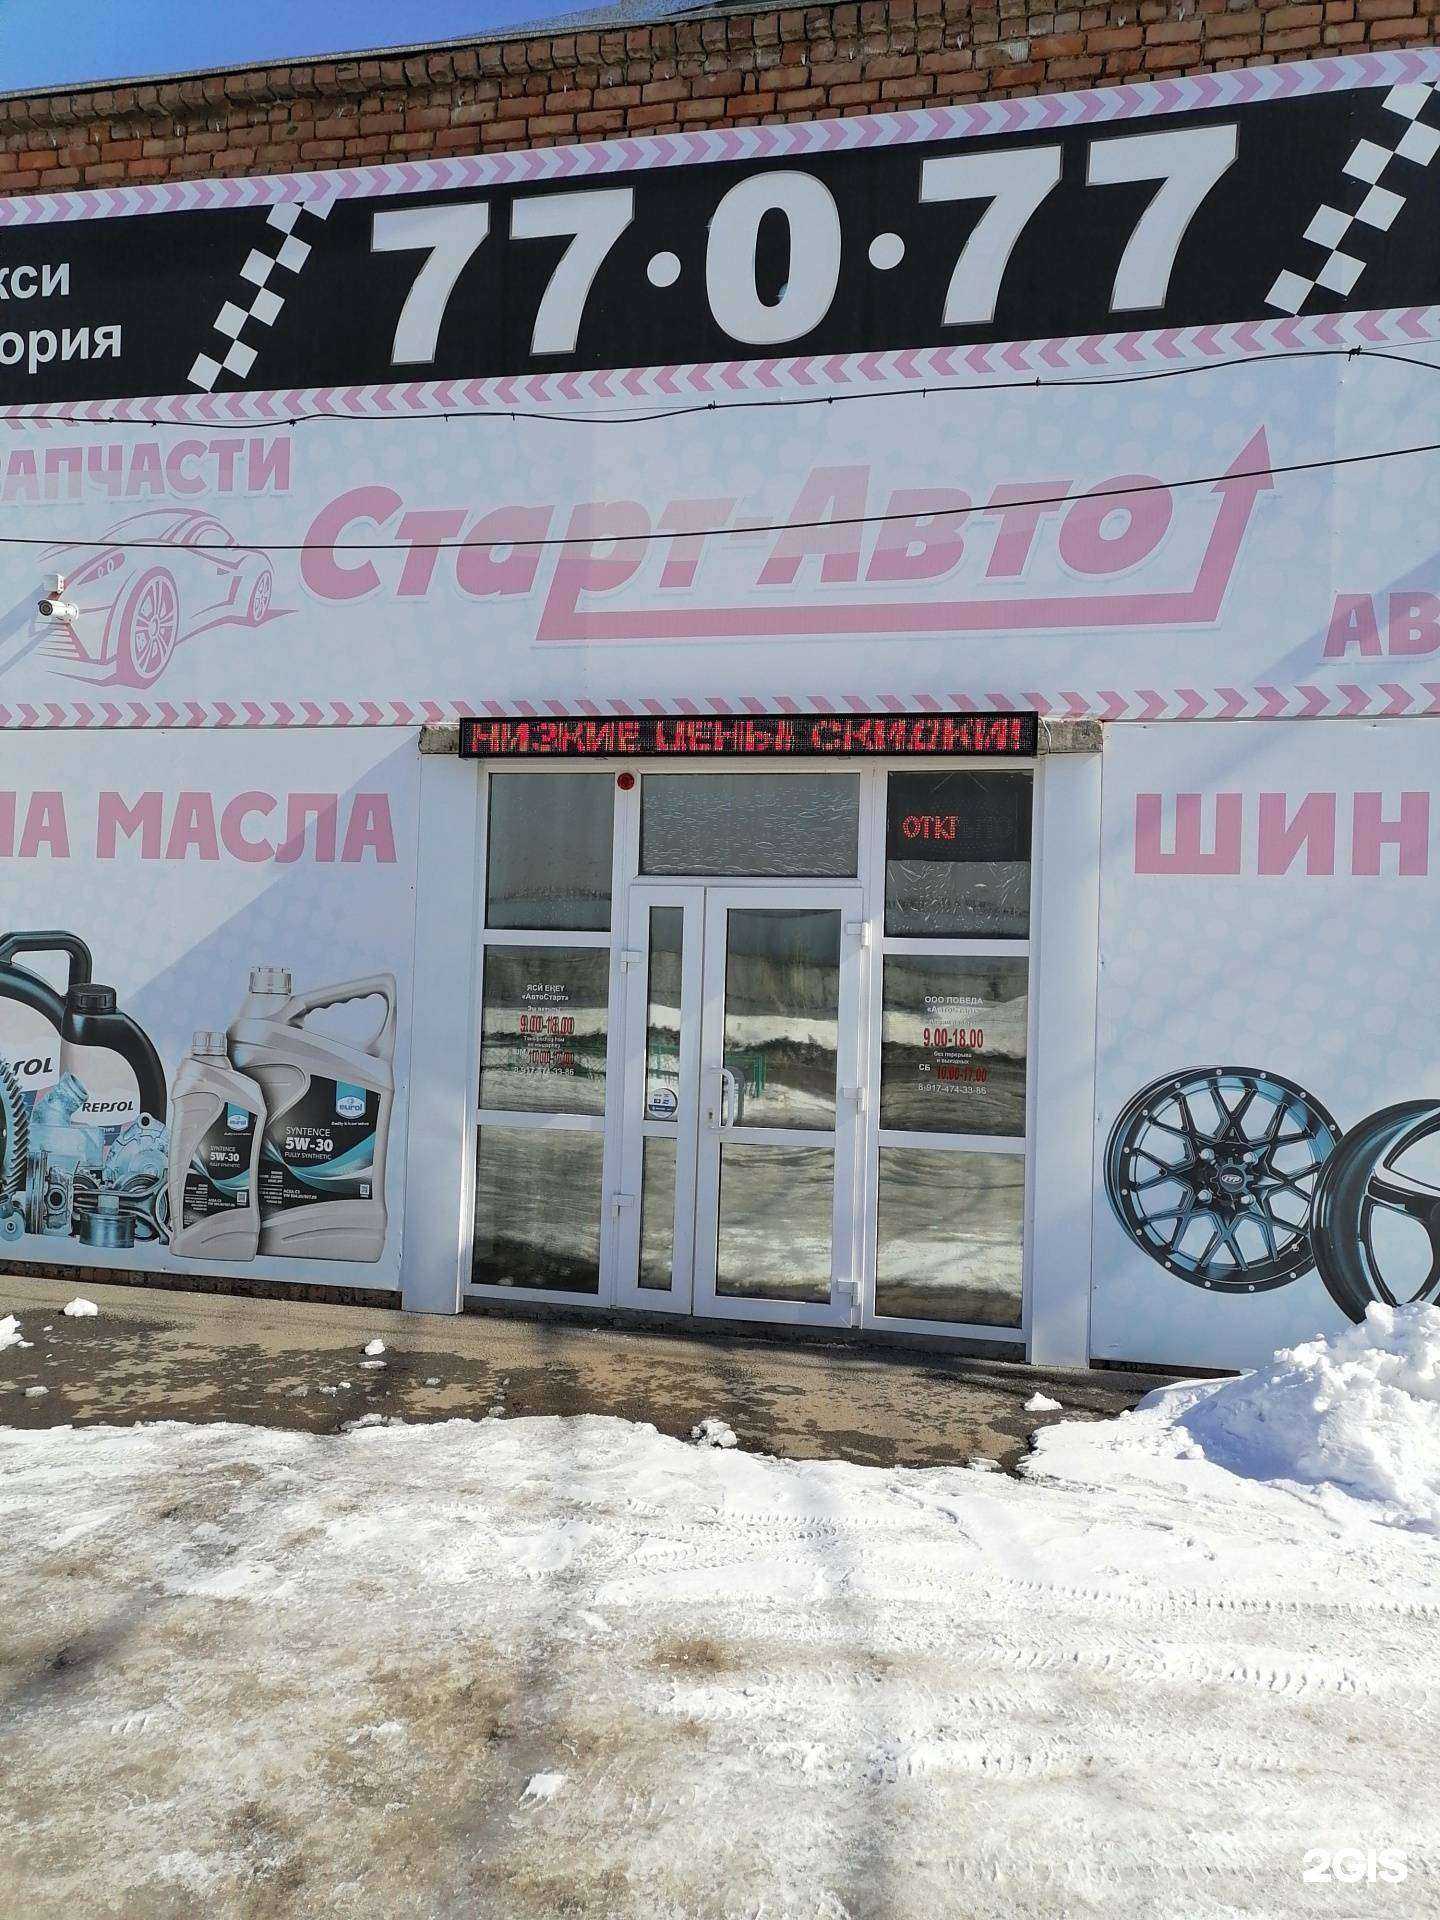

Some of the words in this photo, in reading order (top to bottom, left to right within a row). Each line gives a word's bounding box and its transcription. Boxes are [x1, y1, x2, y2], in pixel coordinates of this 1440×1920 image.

[0, 324, 122, 374] ория
[299, 464, 1174, 612] Старт-Авто
[470, 720, 640, 753] НИЗКИЕ
[655, 719, 794, 752] ЦЕНЫ
[96, 791, 398, 864] МАСЛА
[1133, 791, 1431, 876] ШИН
[923, 1028, 984, 1048] 9.00-18.00
[81, 1101, 134, 1113] REPSOL
[284, 1136, 334, 1152] 5W-30
[285, 1127, 331, 1137] SYNTENCE
[210, 1152, 240, 1162] 5W-30
